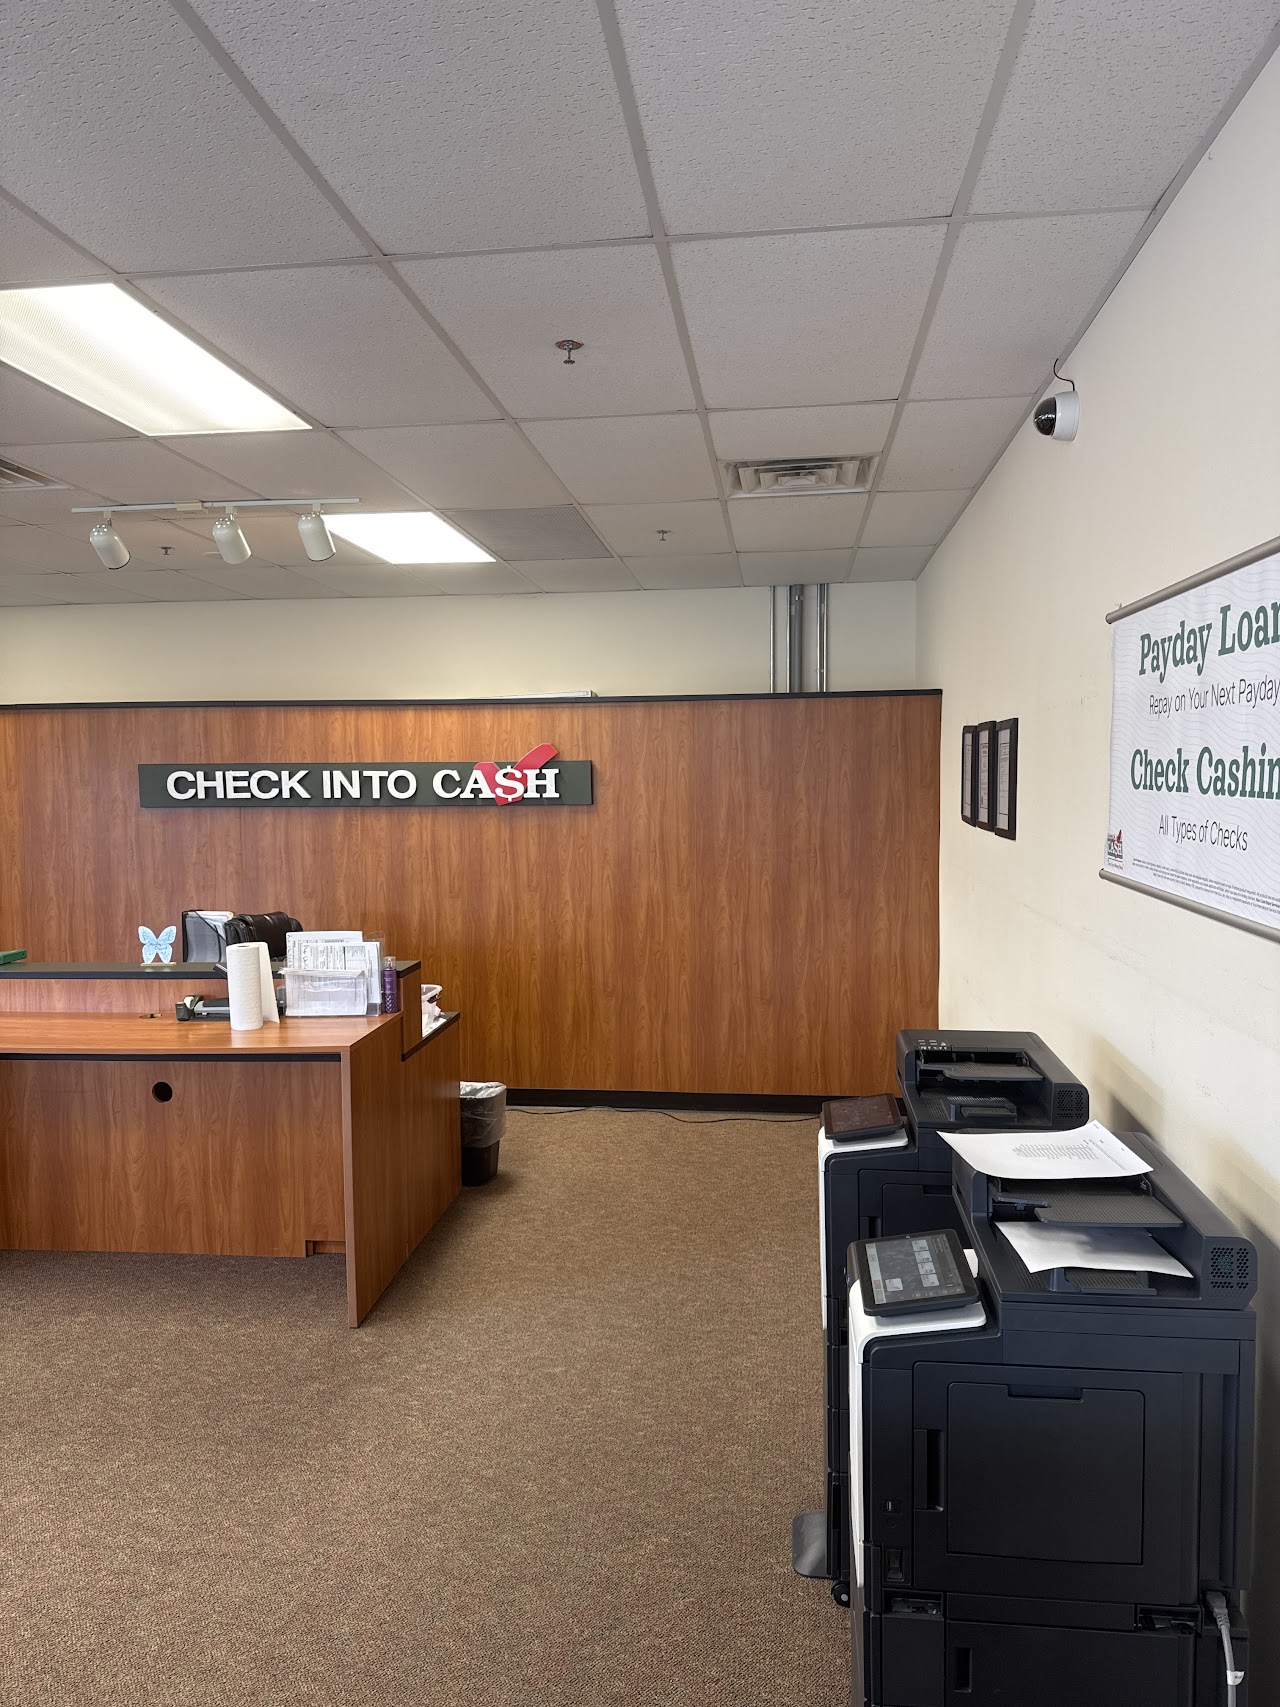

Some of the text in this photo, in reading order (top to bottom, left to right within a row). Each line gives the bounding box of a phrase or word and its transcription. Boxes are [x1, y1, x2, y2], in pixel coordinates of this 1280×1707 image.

[1139, 620, 1213, 684] Payday
[1149, 674, 1280, 719] Repay on Your Next Payday
[166, 770, 312, 800] CHECK
[322, 769, 417, 800] INTO
[1130, 748, 1190, 793] Check
[1159, 814, 1248, 851] All Types of Checks
